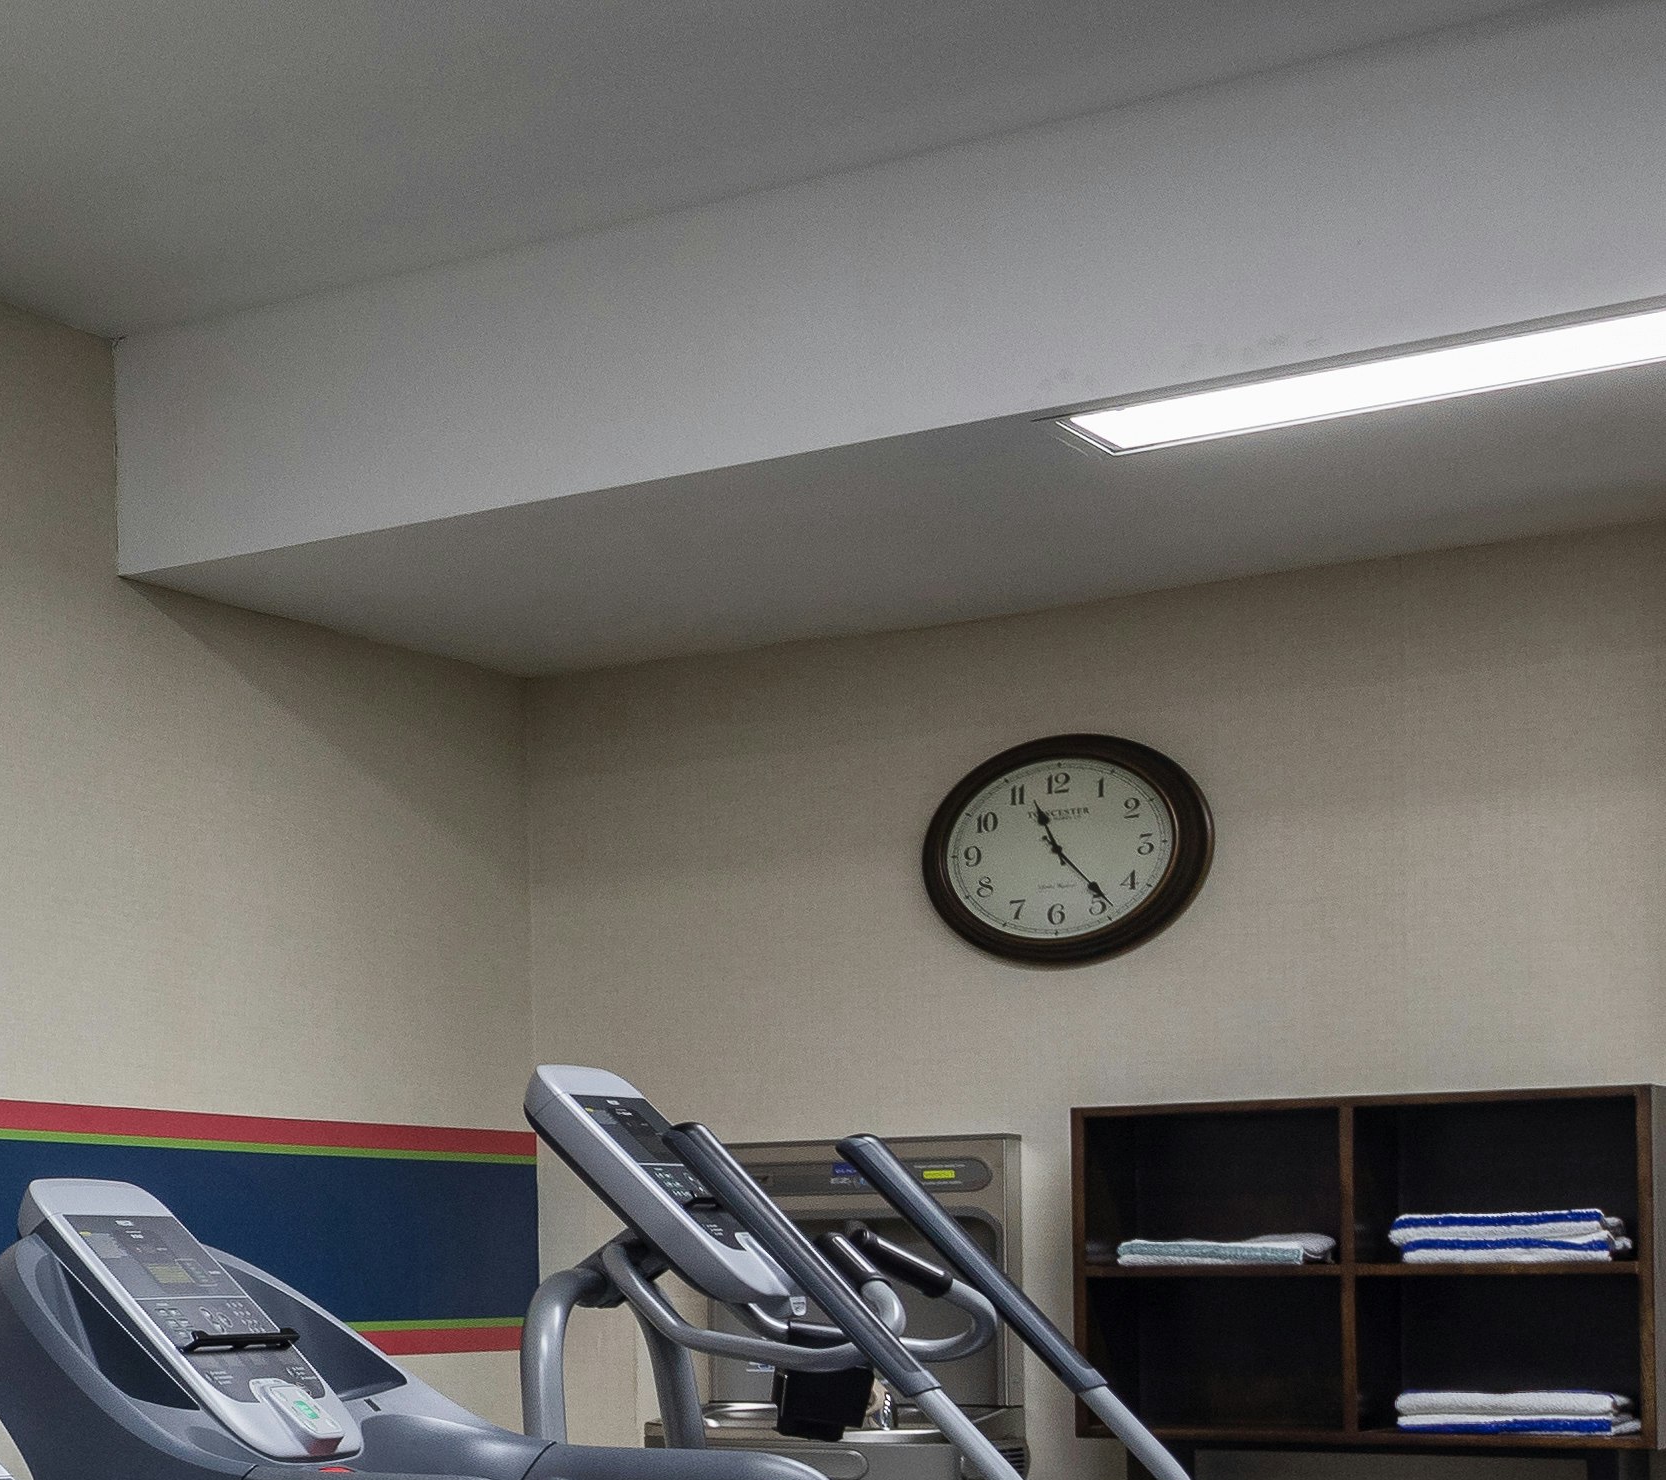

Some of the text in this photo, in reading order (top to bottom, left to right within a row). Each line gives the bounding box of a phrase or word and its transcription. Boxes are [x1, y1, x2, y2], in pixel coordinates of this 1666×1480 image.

[1046, 772, 1071, 794] 12
[1096, 777, 1105, 798] 1
[1010, 784, 1025, 806] 11
[1123, 797, 1141, 819] 2
[976, 811, 999, 833] 10
[1137, 832, 1154, 855] 3
[963, 845, 982, 867] 9
[976, 876, 994, 898] 8
[1119, 869, 1139, 890] 4
[1009, 898, 1026, 920] 7
[1047, 903, 1066, 925] 6
